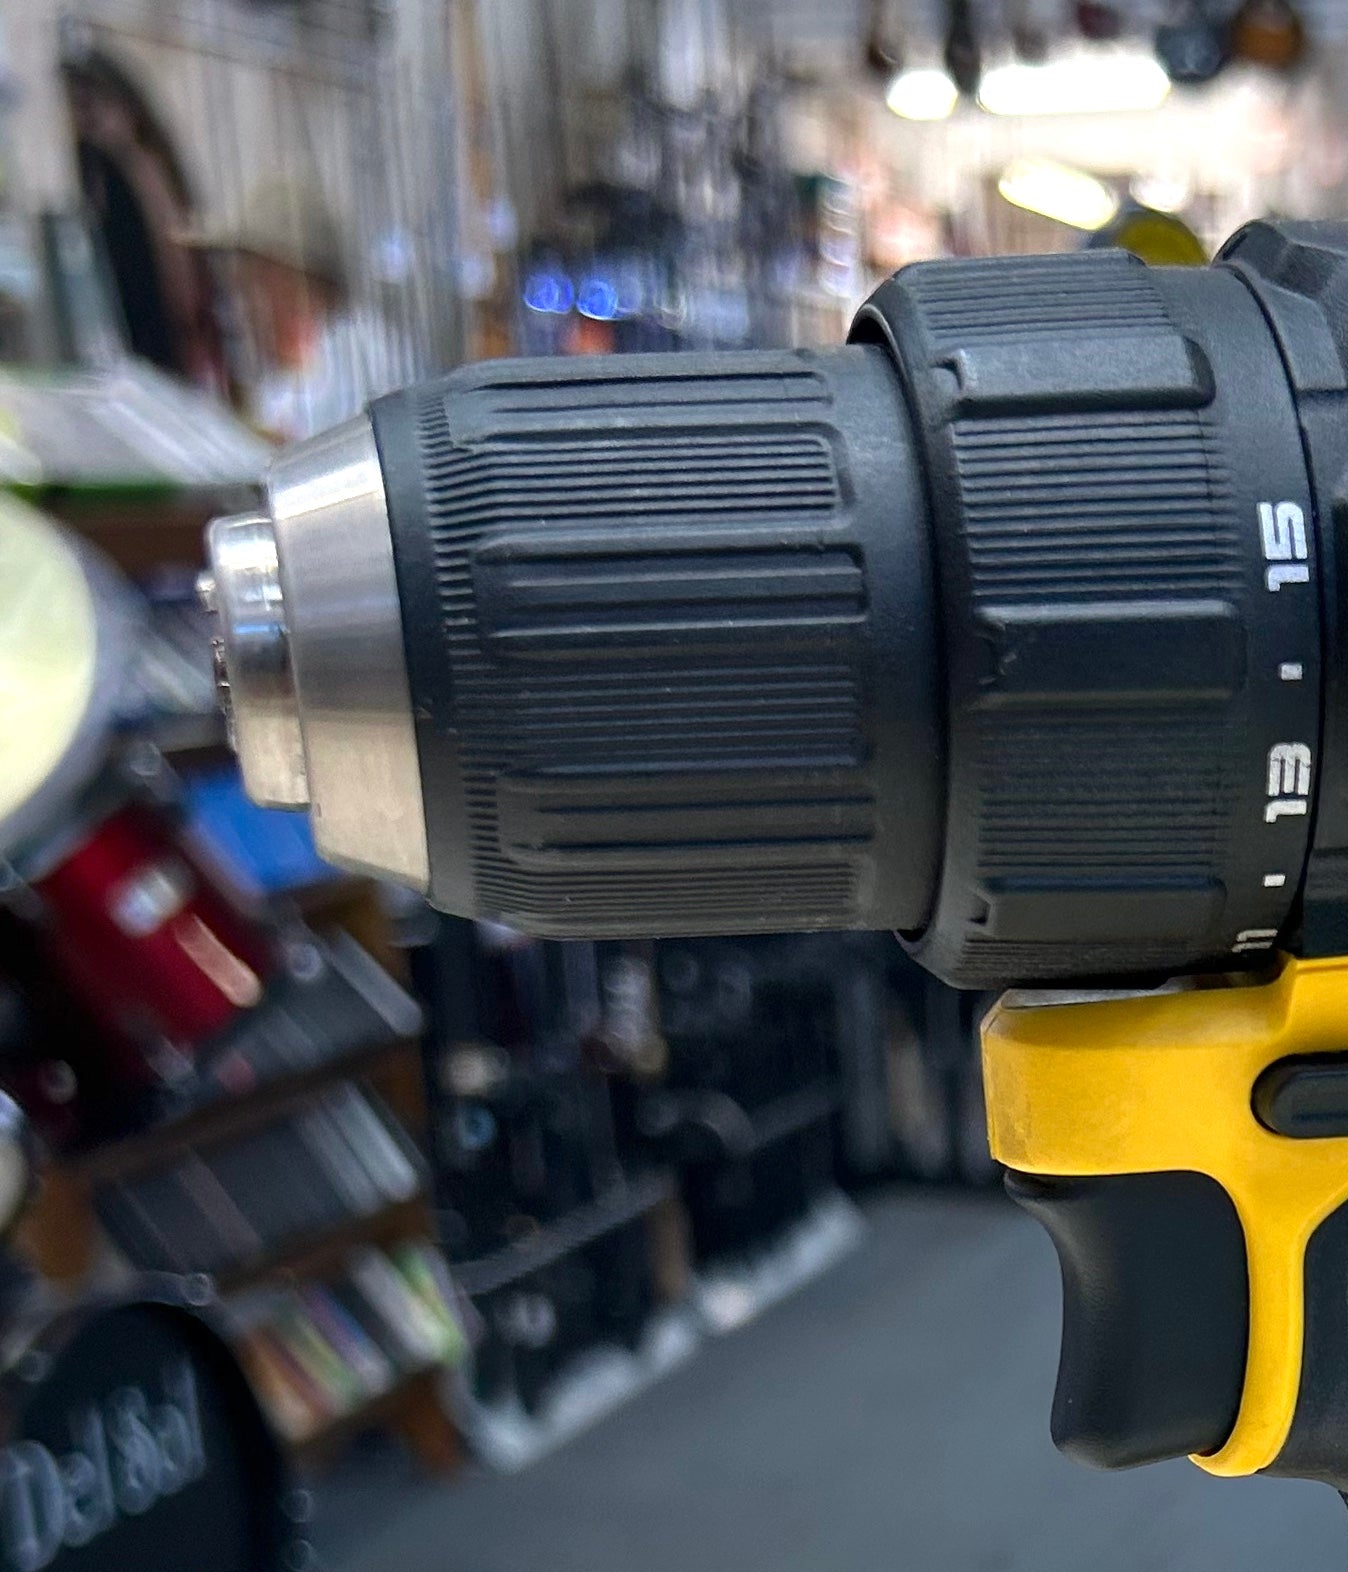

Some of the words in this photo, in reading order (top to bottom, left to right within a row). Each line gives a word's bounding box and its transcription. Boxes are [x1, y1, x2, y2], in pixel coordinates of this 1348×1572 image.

[1258, 501, 1310, 592] 15
[1264, 742, 1313, 823] 13
[1231, 928, 1278, 953] 11
